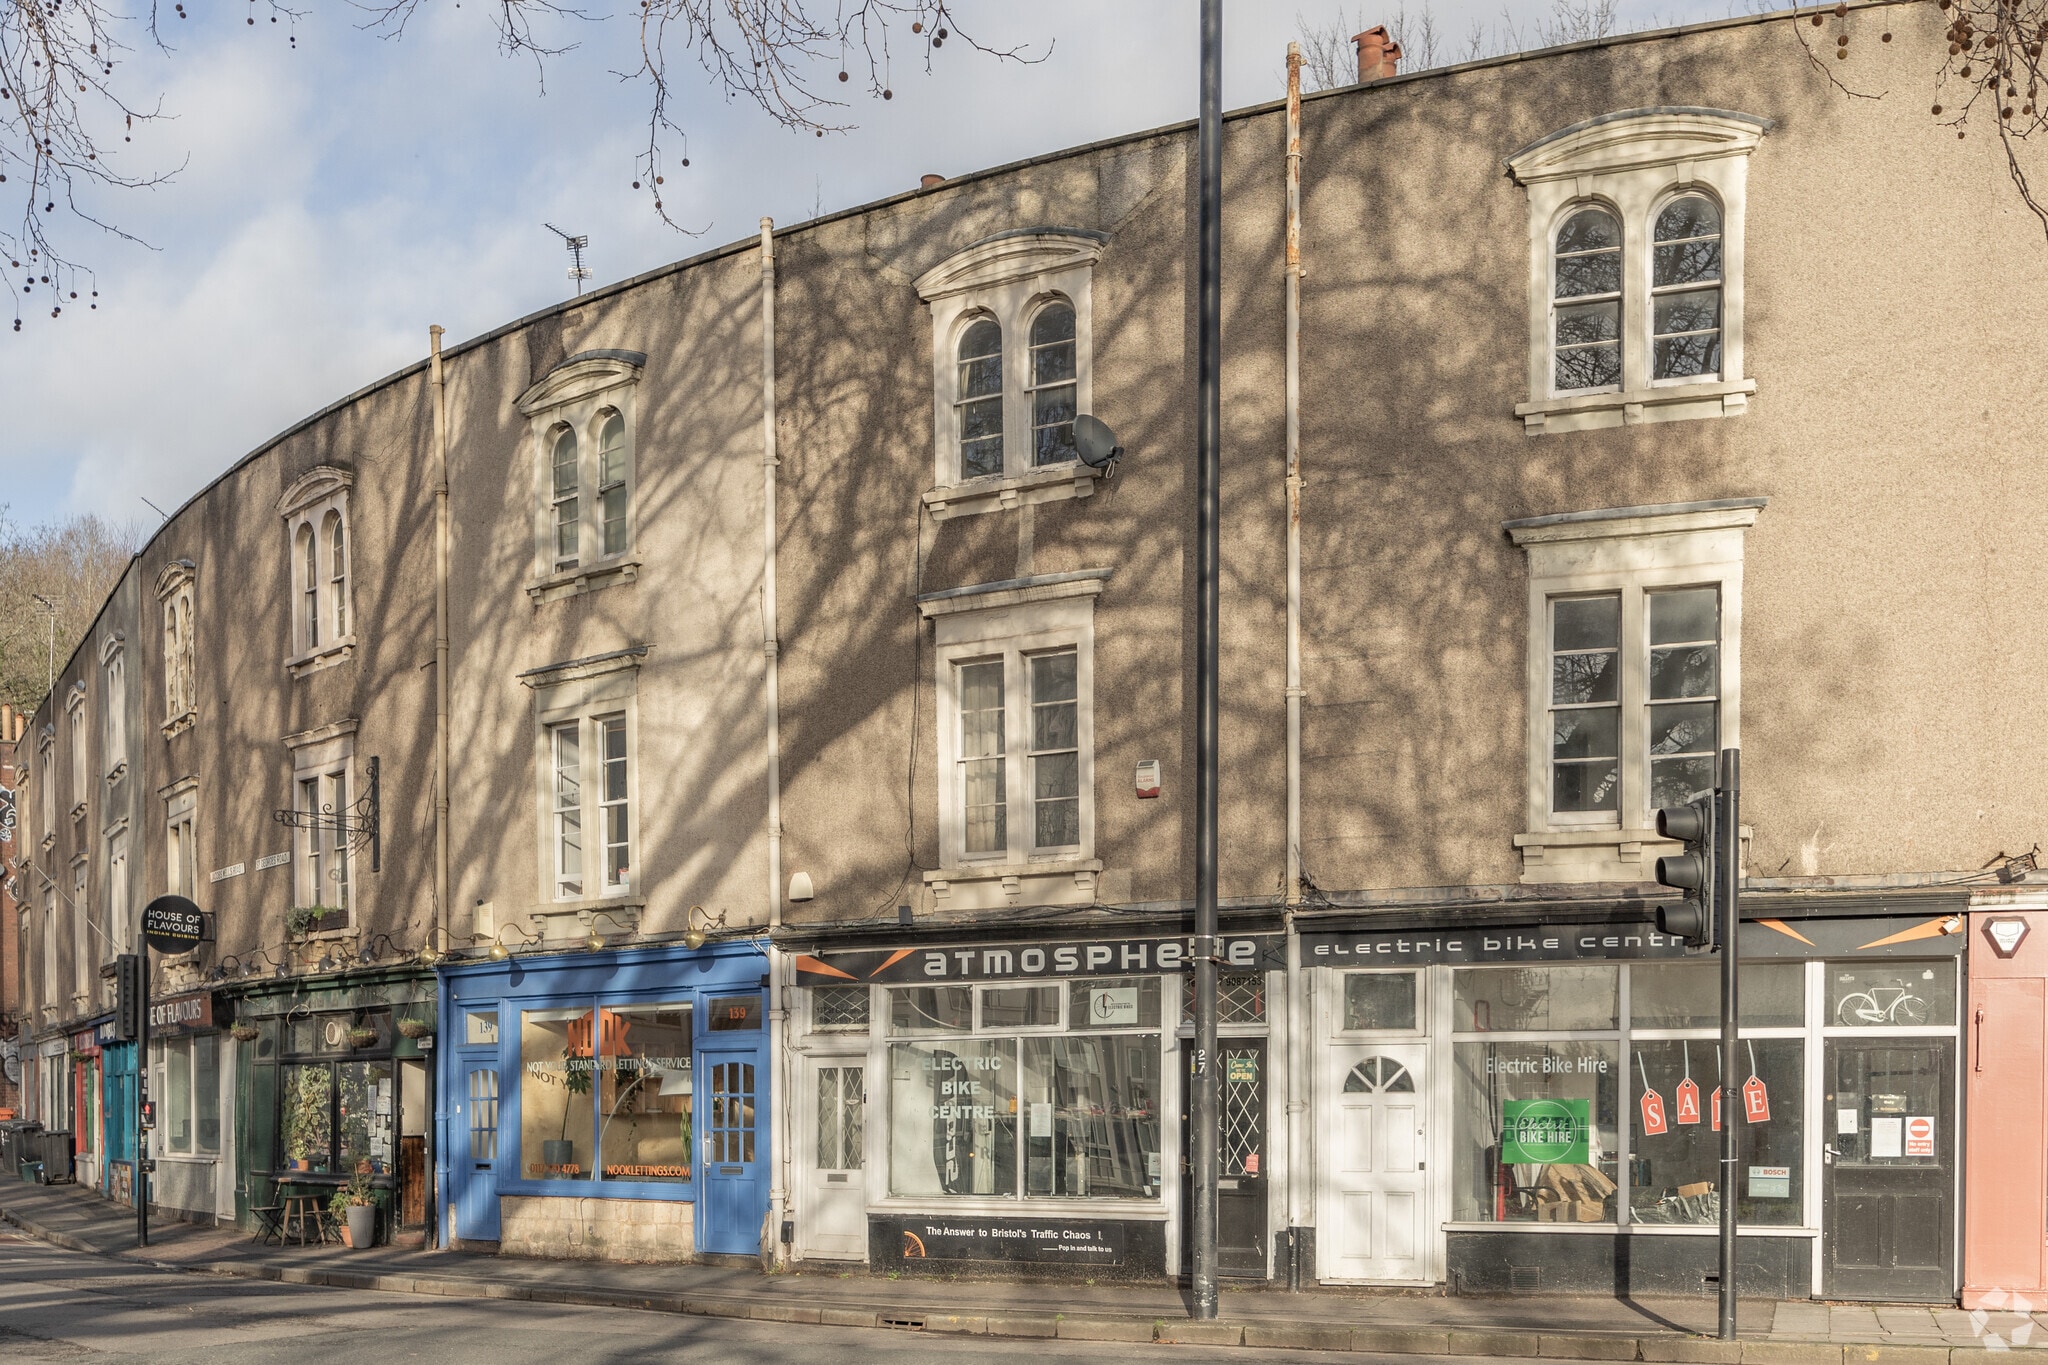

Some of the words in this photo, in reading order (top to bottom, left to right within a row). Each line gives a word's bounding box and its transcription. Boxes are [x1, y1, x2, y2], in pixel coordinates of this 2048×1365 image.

[148, 910, 182, 922] HOUSE
[186, 914, 201, 924] OF
[147, 920, 200, 934] FLAVOURS
[172, 932, 200, 940] CUISINE
[156, 1004, 166, 1025] OF
[167, 999, 201, 1024] FLAVOURS
[729, 1007, 746, 1020] 139
[479, 1021, 493, 1034] 139
[567, 1008, 632, 1057] NOOK
[526, 1061, 543, 1073] NOT
[544, 1060, 567, 1071] YOUR
[570, 1059, 612, 1071] STANDARD
[615, 1058, 654, 1070] LETTINGS
[656, 1056, 691, 1069] SERVICE
[921, 1057, 1002, 1071] ELECTRIC
[1486, 1056, 1538, 1074] Electric
[1543, 1056, 1573, 1074] Bike
[1577, 1056, 1608, 1074] Hire
[1230, 1072, 1253, 1080] OPEN
[941, 1081, 981, 1095] BIKE
[929, 1105, 995, 1120] CENTRE
[1519, 1117, 1569, 1130] Electric
[1520, 1131, 1544, 1143] BIKE
[1547, 1131, 1572, 1143] HIRE
[562, 1164, 580, 1174] 4778
[606, 1164, 691, 1177] NOOKLETTINGS.COM
[926, 1226, 942, 1236] The
[943, 1227, 975, 1237] Answer
[978, 1228, 988, 1237] to
[992, 1228, 1027, 1238] Bristol's
[1031, 1229, 1059, 1239] Traffic
[1063, 1230, 1091, 1240] Chaos
[1058, 1244, 1069, 1252] Pop
